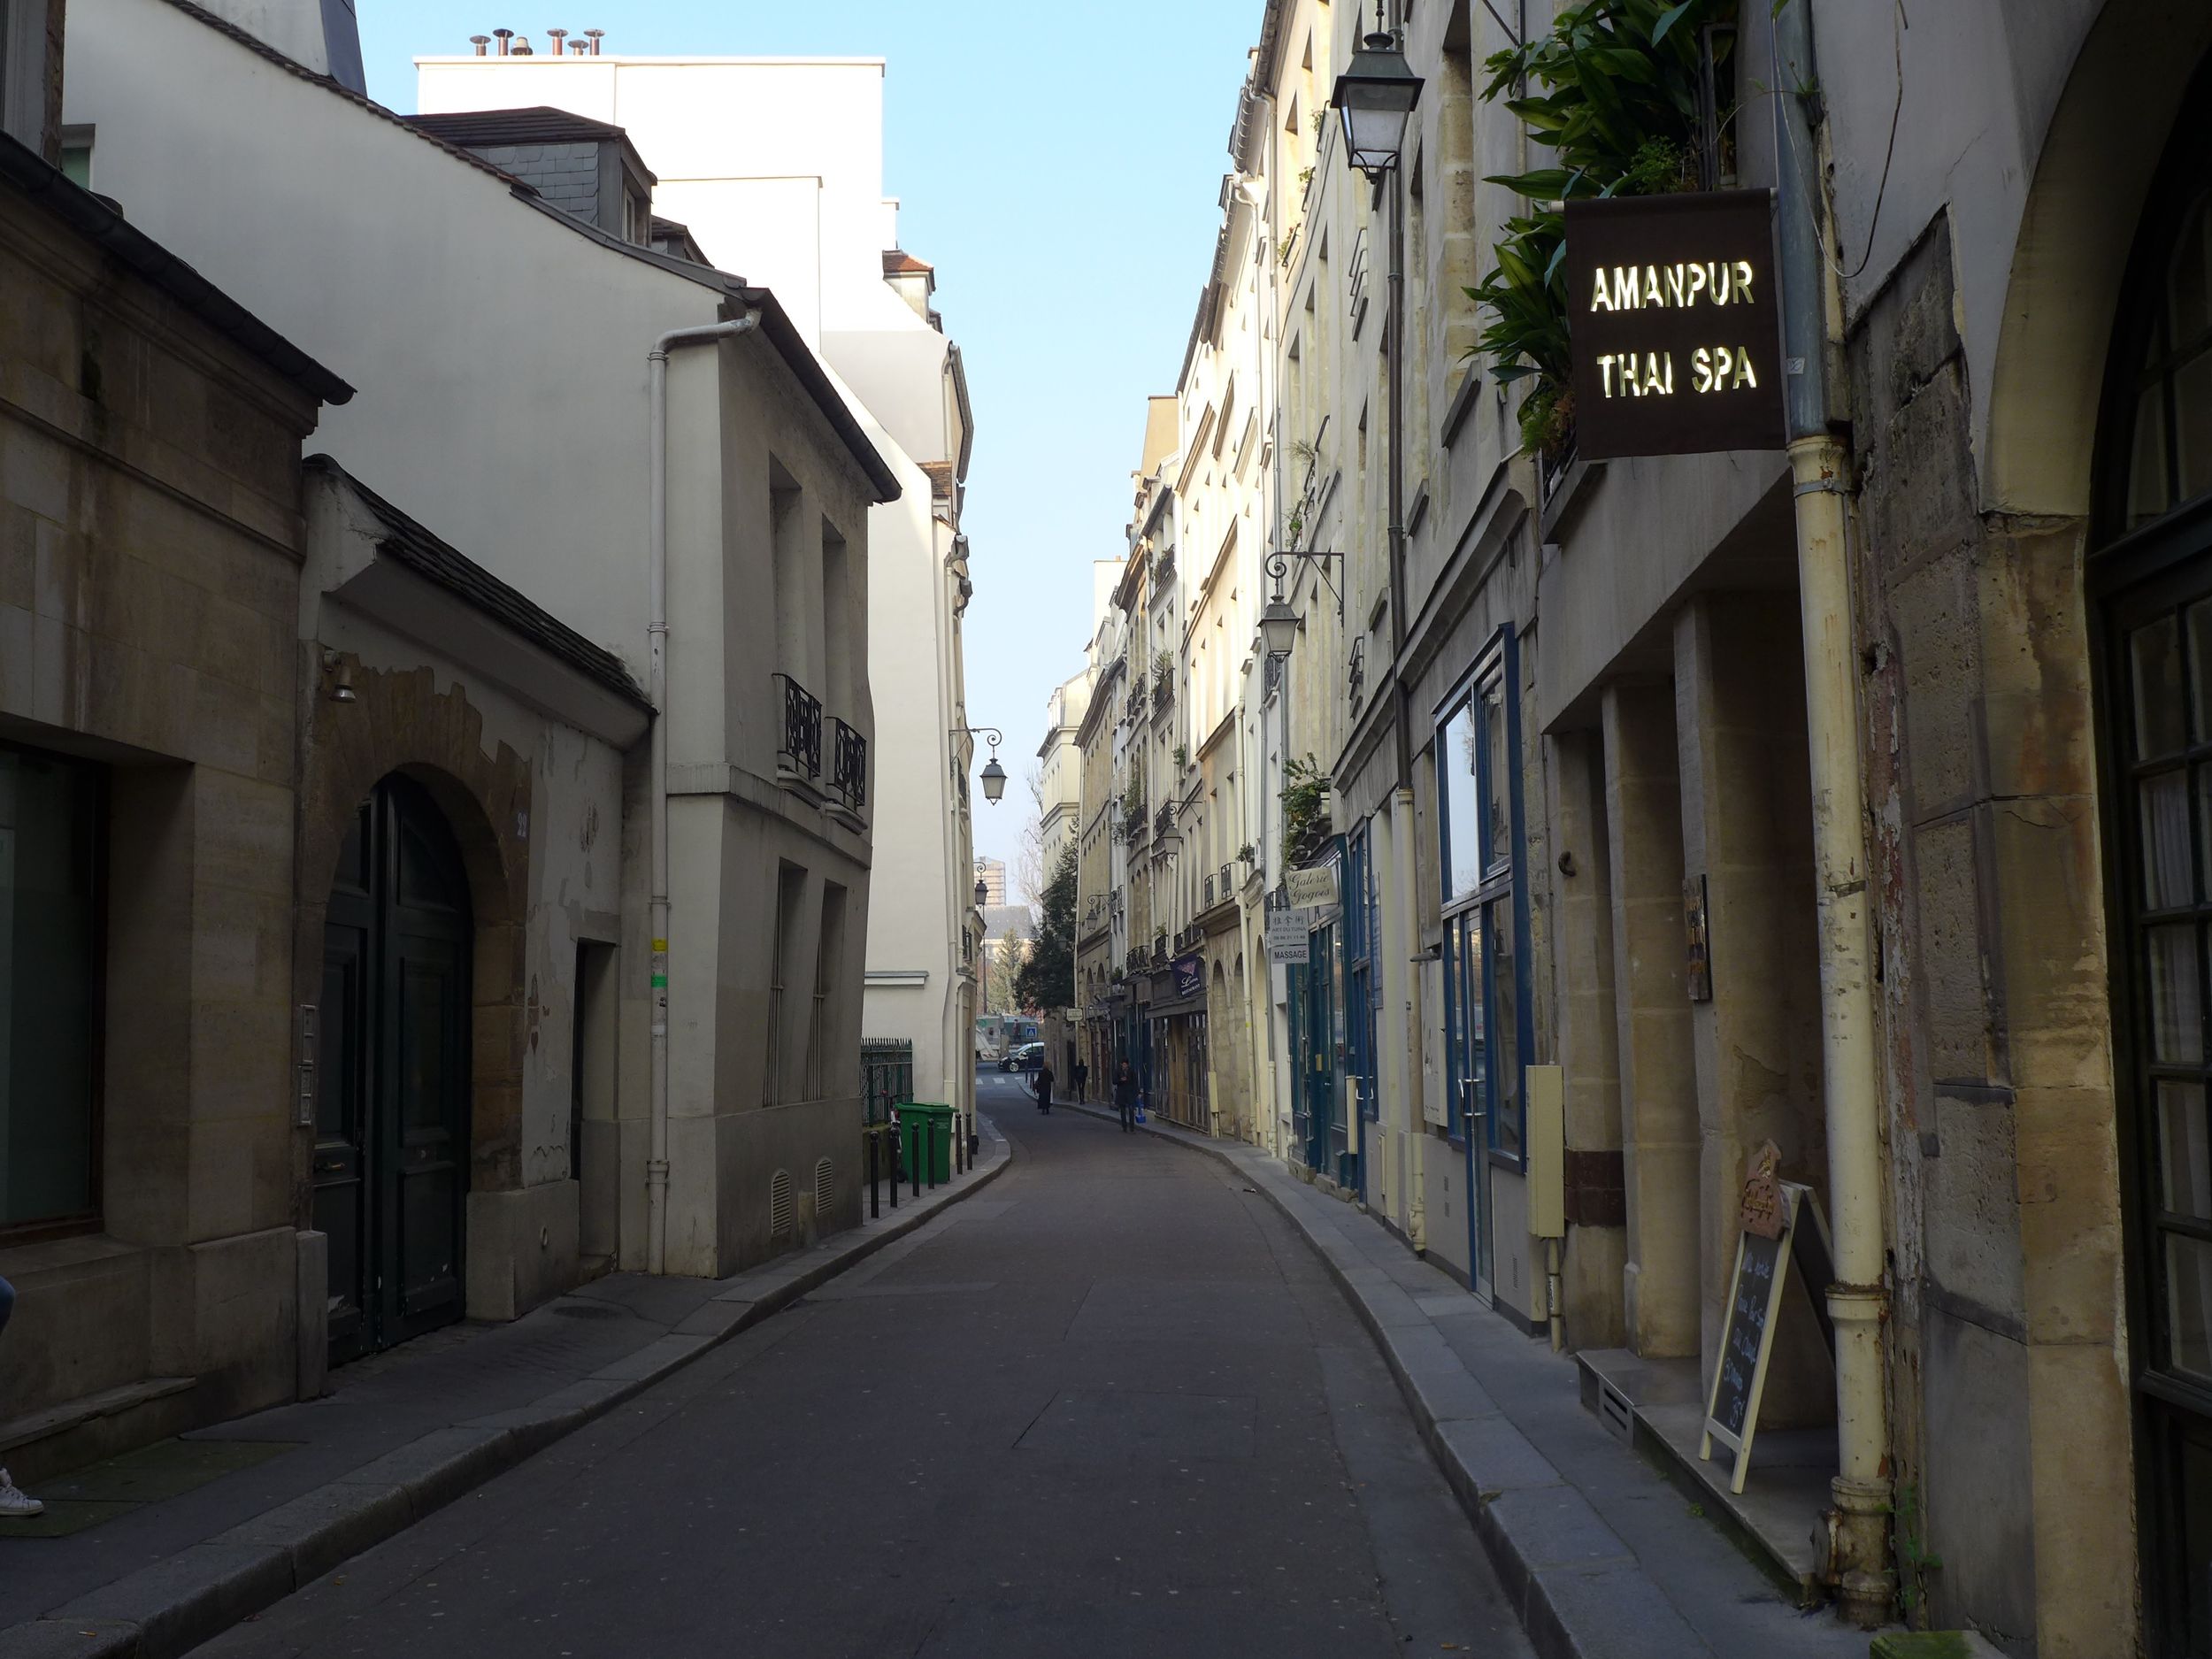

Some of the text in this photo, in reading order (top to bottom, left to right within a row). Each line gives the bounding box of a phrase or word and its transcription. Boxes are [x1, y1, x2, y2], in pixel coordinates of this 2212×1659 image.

[1590, 261, 1755, 312] AMANPUR
[1596, 346, 1756, 398] THAI SPA
[517, 812, 527, 838] 22
[1289, 872, 1329, 890] Galerie
[1274, 950, 1307, 959] MASSAGE
